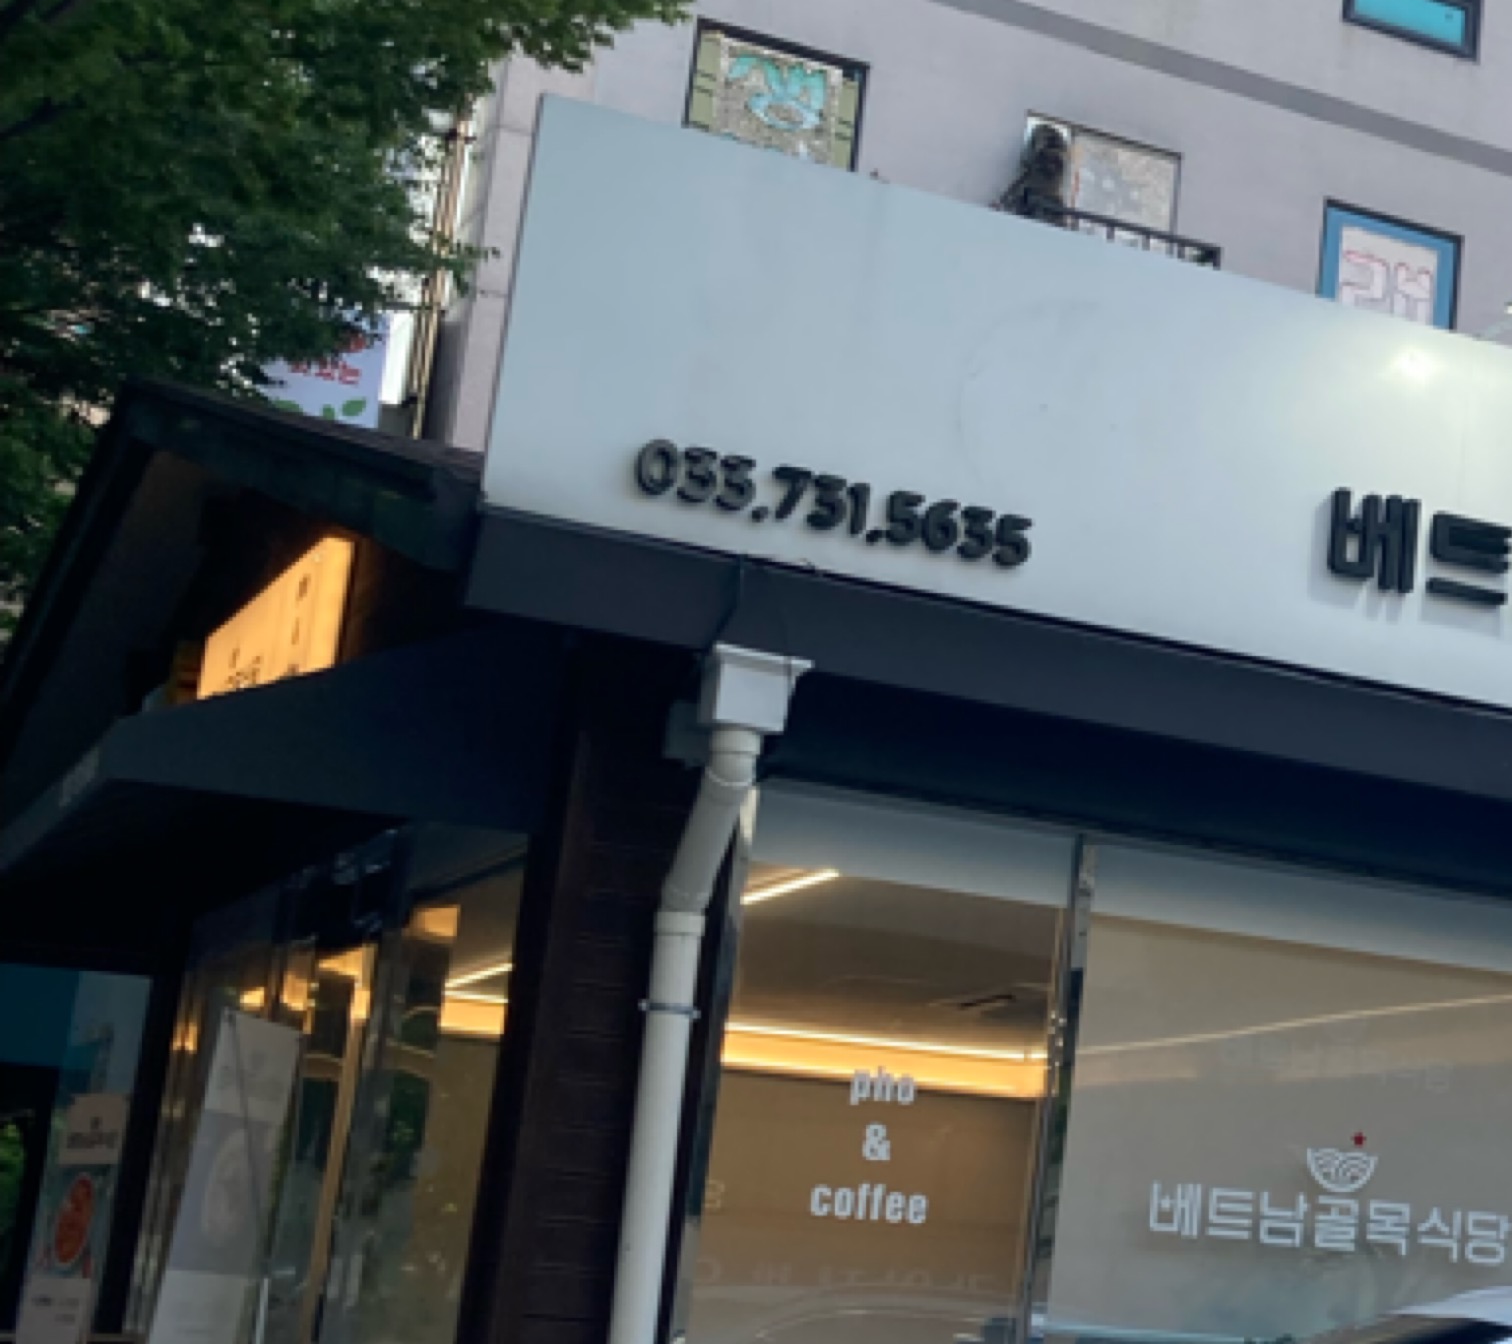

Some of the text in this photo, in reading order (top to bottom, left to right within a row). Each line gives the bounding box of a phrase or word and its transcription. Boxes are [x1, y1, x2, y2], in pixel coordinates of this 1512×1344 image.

[634, 439, 1034, 569] 033.731.5635
[848, 1067, 917, 1107] pho
[861, 1122, 892, 1163] &
[809, 1180, 928, 1226] coffee
[1147, 1180, 1512, 1267] 베트남골목식당
